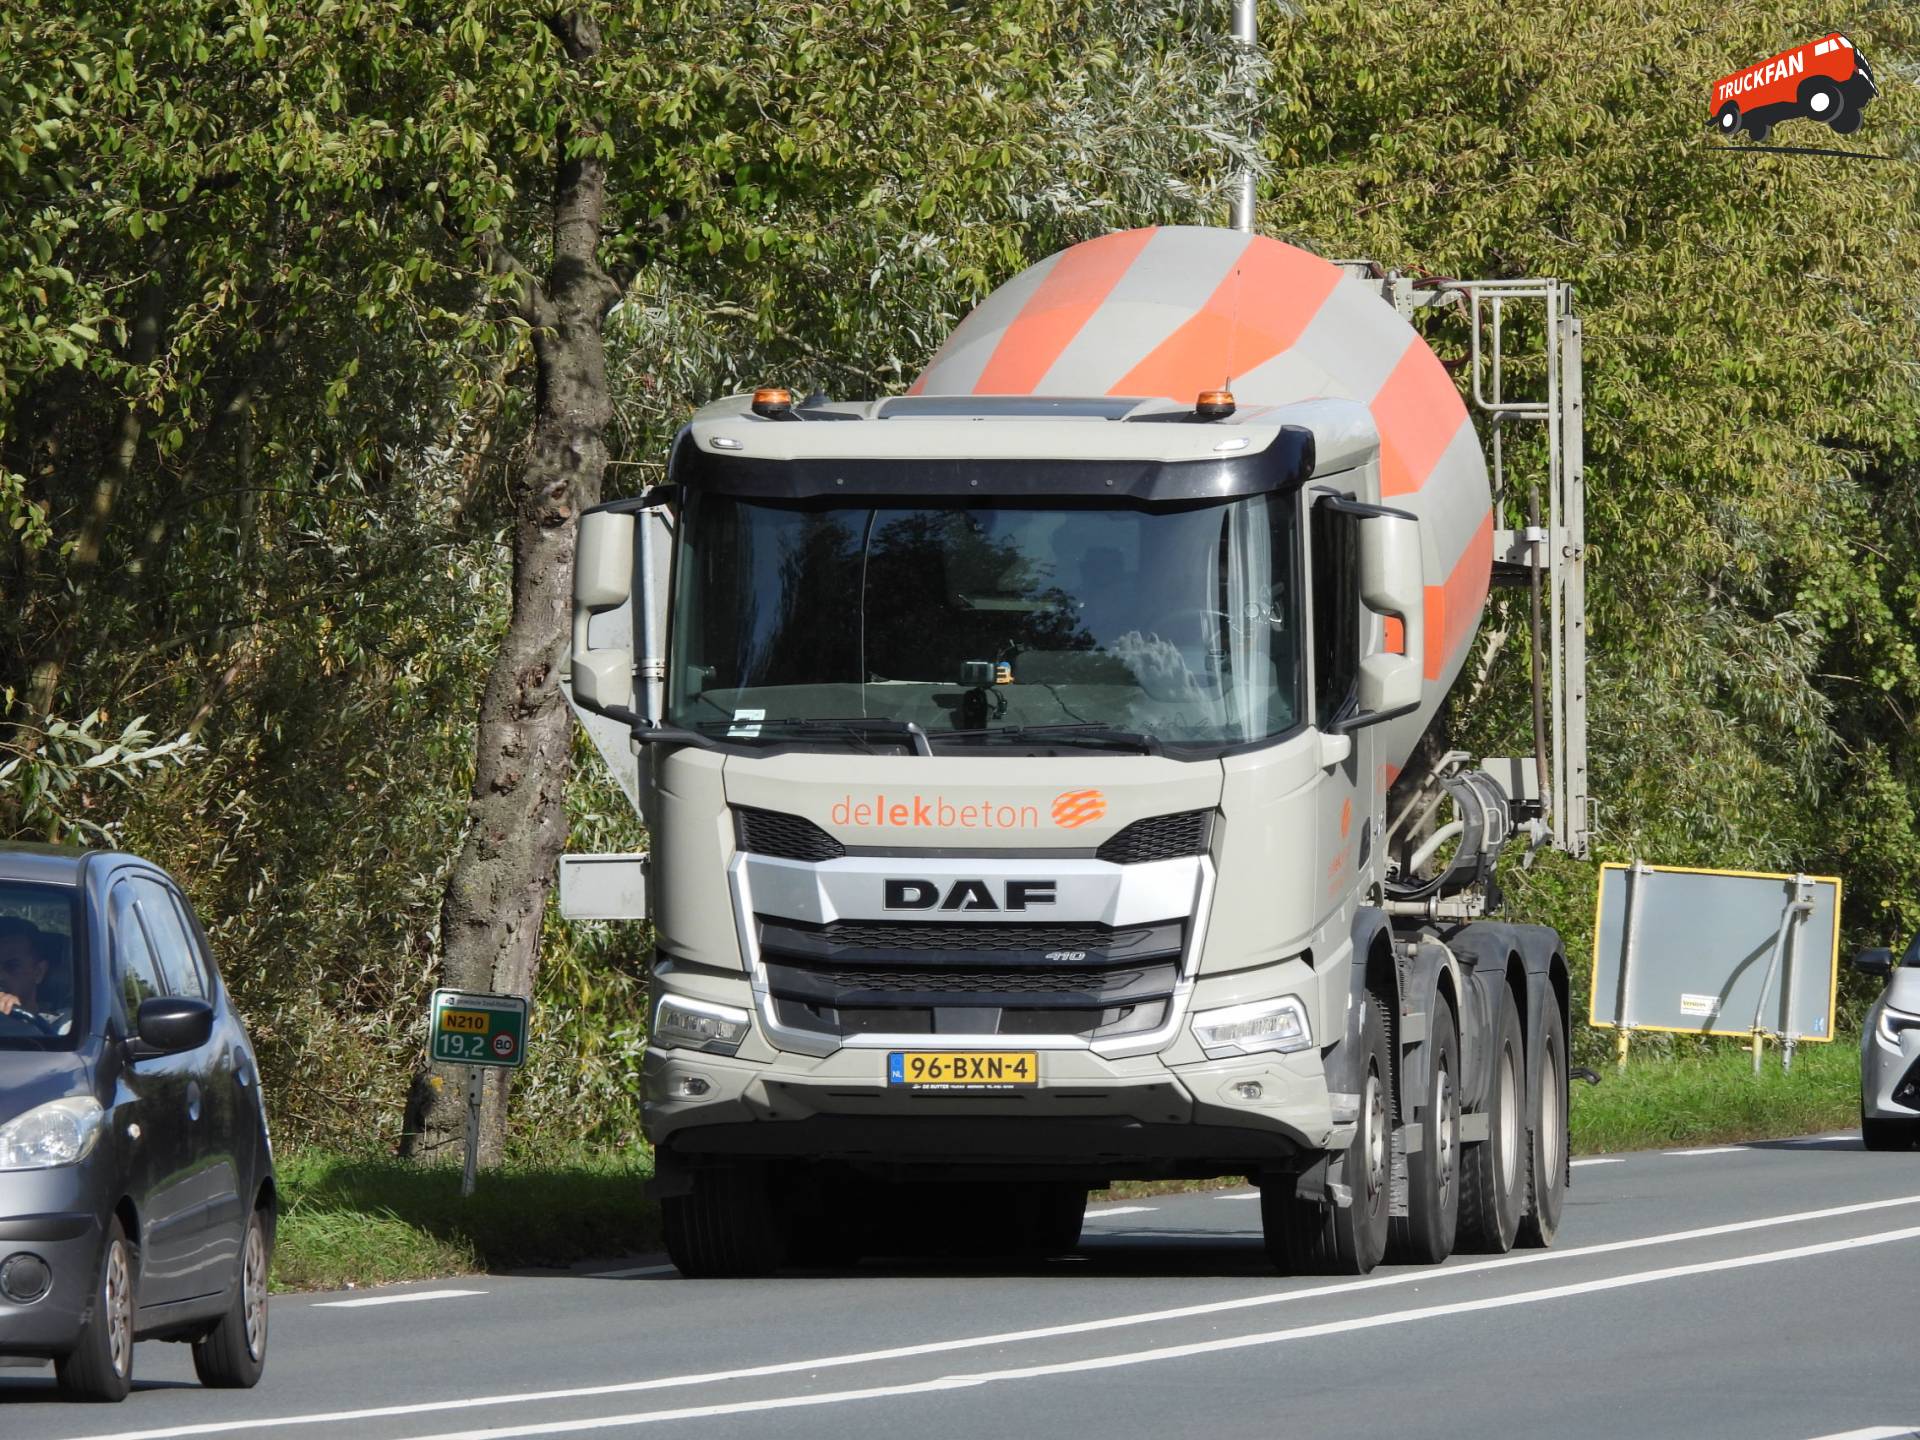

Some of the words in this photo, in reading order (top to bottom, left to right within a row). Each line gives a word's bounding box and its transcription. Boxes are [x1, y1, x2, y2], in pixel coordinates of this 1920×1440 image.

[831, 795, 1038, 828] delekbeton
[882, 878, 1057, 912] DAF
[1045, 951, 1086, 961] 410
[447, 1014, 484, 1029] N210
[440, 1033, 485, 1057] 19,2
[495, 1039, 512, 1050] 80
[911, 1057, 1028, 1079] 96-BXN-4
